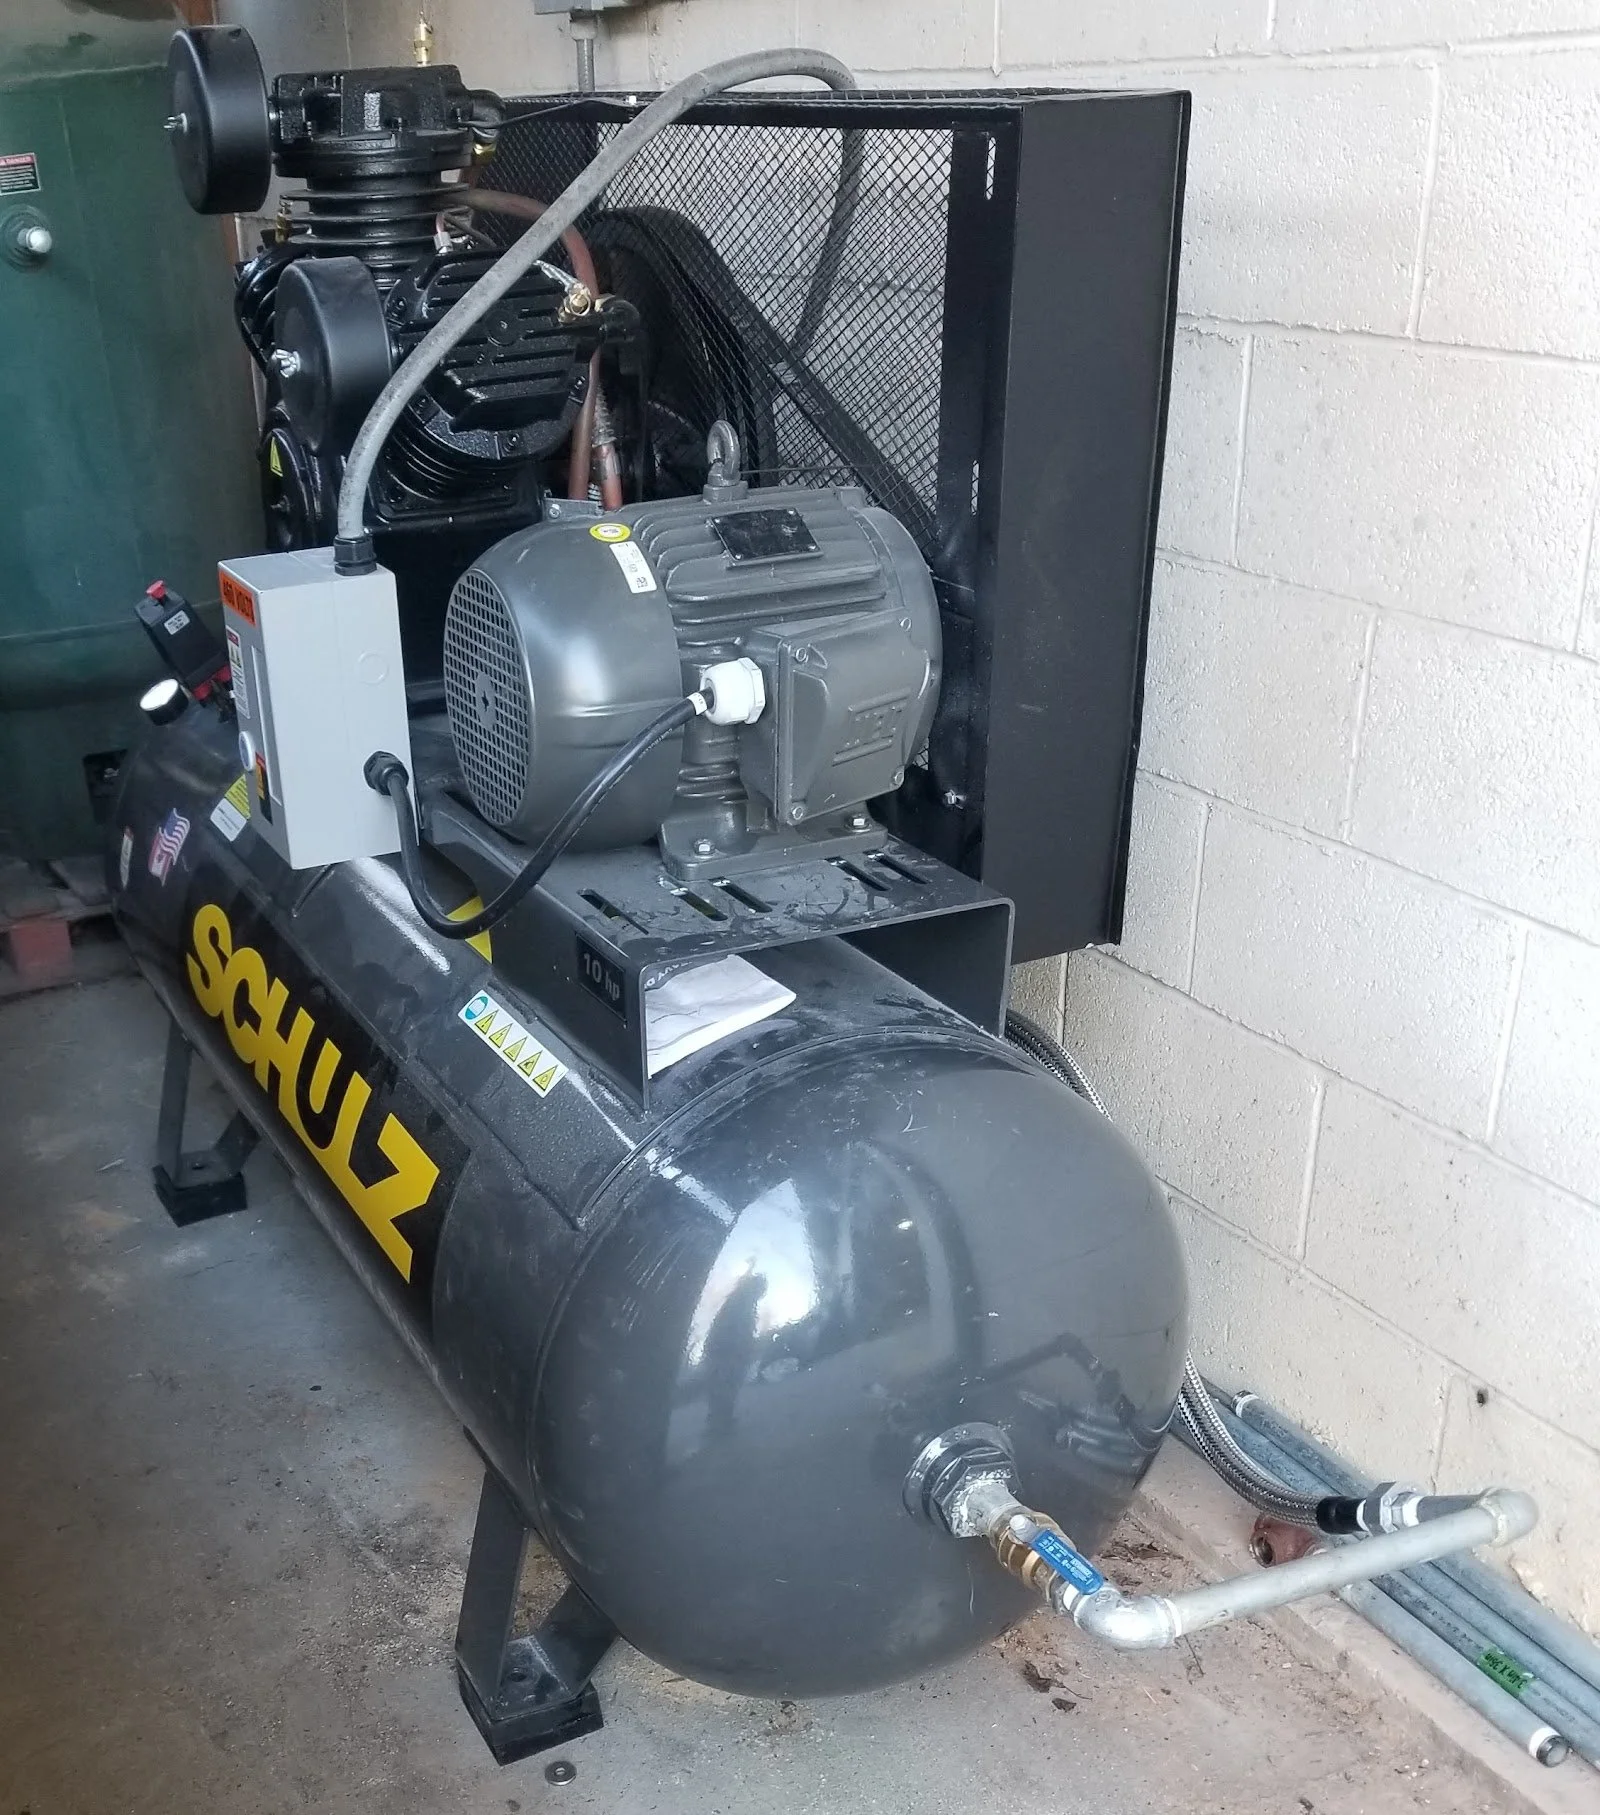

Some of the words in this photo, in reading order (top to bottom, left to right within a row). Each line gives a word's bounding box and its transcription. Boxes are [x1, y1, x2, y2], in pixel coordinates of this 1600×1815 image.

[583, 953, 602, 983] 10
[605, 970, 620, 1001] hp
[186, 903, 440, 1284] SCHULZ
